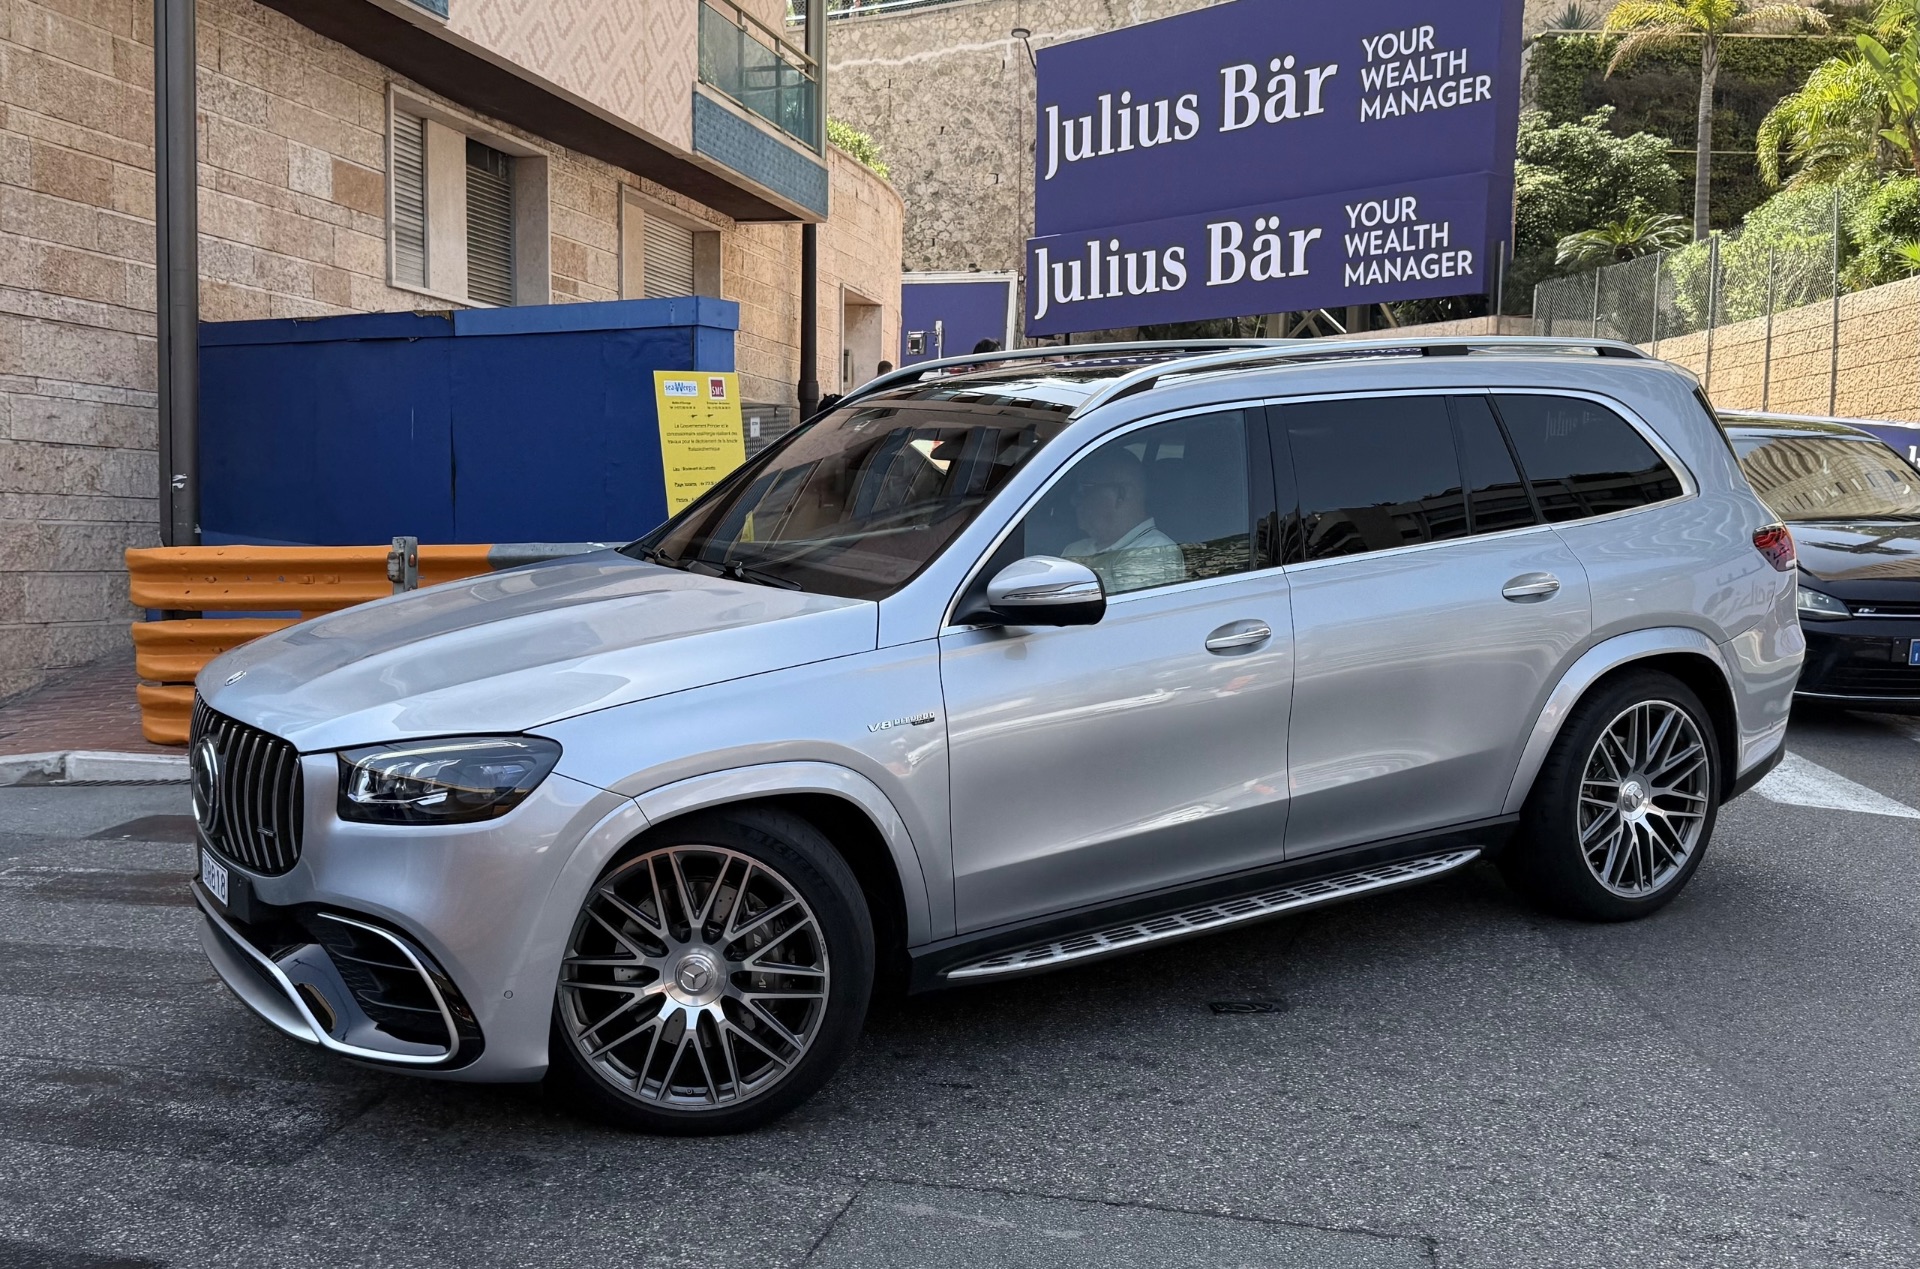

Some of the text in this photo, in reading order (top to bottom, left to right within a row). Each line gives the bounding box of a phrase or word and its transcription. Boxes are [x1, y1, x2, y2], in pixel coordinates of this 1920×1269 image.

[1362, 25, 1435, 62] YOUR
[1361, 48, 1467, 92] WEALTH
[1361, 75, 1492, 122] MANAGER
[1045, 55, 1338, 180] Julius Bär
[1345, 197, 1417, 229] YOUR
[1345, 222, 1449, 258] WEALTH
[1034, 216, 1322, 320] Julius Bär
[1345, 251, 1473, 288] MANAGER
[711, 386, 723, 396] SMC
[867, 721, 892, 733] V8
